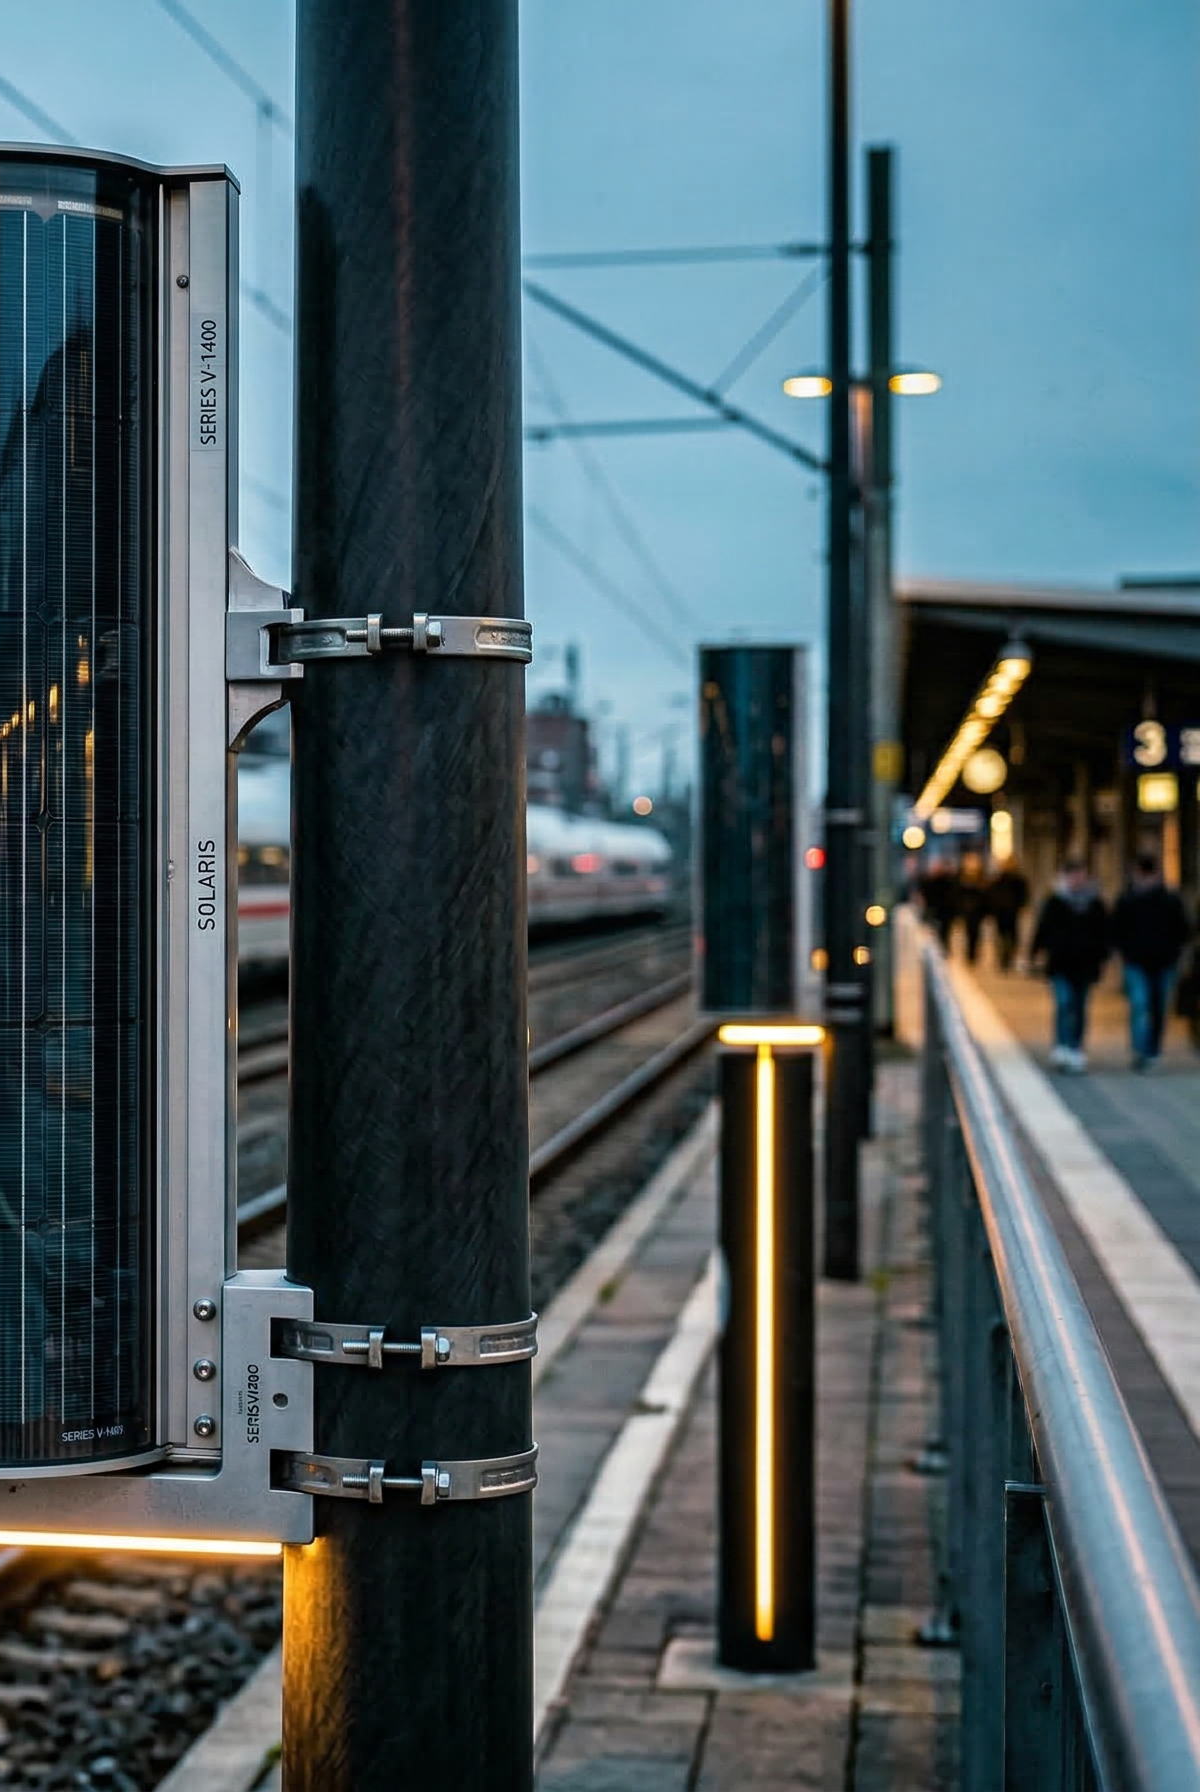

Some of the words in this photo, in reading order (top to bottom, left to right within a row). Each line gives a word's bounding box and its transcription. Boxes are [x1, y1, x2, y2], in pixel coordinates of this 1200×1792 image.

[200, 320, 216, 383] V-1400
[200, 387, 216, 445] SERIES
[1133, 720, 1167, 766] 3
[198, 840, 215, 930] SOLARIS
[62, 1429, 95, 1442] SERIES
